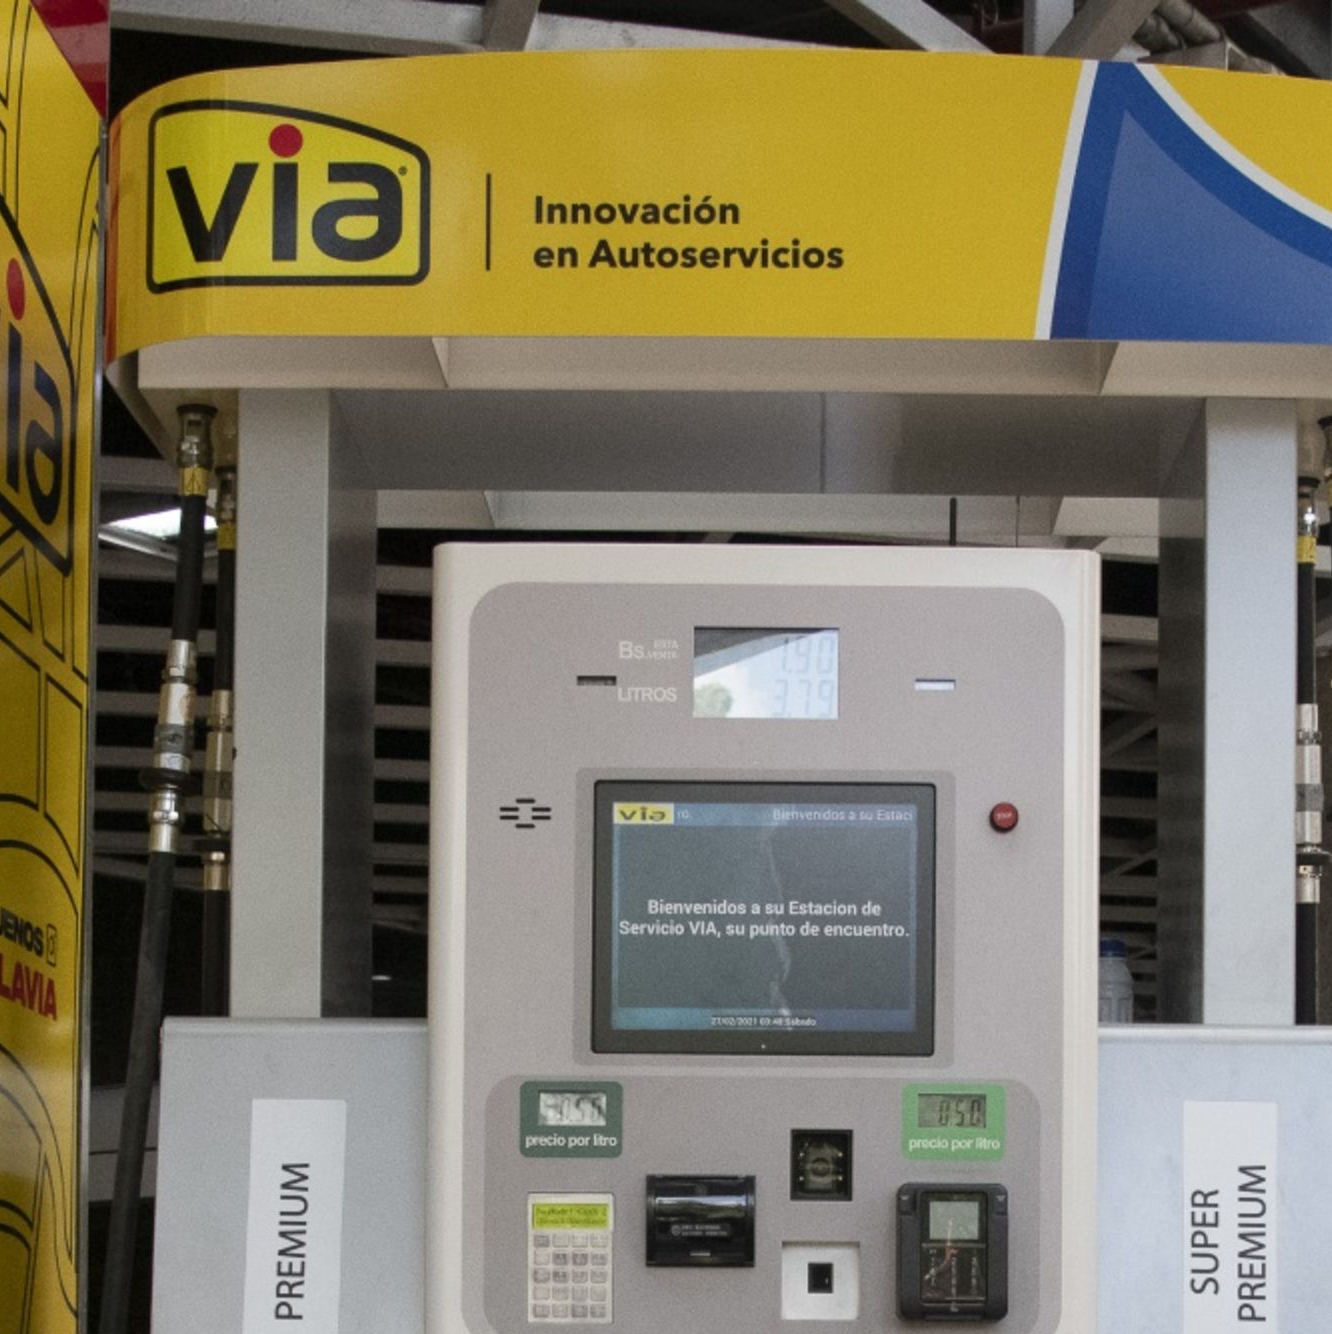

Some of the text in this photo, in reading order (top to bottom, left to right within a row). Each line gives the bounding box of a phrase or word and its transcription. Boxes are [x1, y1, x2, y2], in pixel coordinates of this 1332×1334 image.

[167, 124, 402, 262] via
[534, 194, 740, 225] Innovación
[533, 238, 844, 269] en Autoservicios
[617, 686, 677, 702] LITROS
[619, 806, 666, 822] via
[773, 808, 845, 822] Bienvenidos
[849, 811, 856, 822] a
[859, 811, 874, 822] su
[647, 899, 882, 917] Bienvenidos a su Estacion de
[619, 920, 911, 940] Servicio VIA, su punto de encuentro.
[525, 1133, 618, 1149] precio por litro
[908, 1136, 1001, 1152] precio por litro
[274, 1162, 310, 1321] PREMIUM
[1190, 1189, 1220, 1295] SUPER
[1237, 1164, 1267, 1322] PREMIUM
